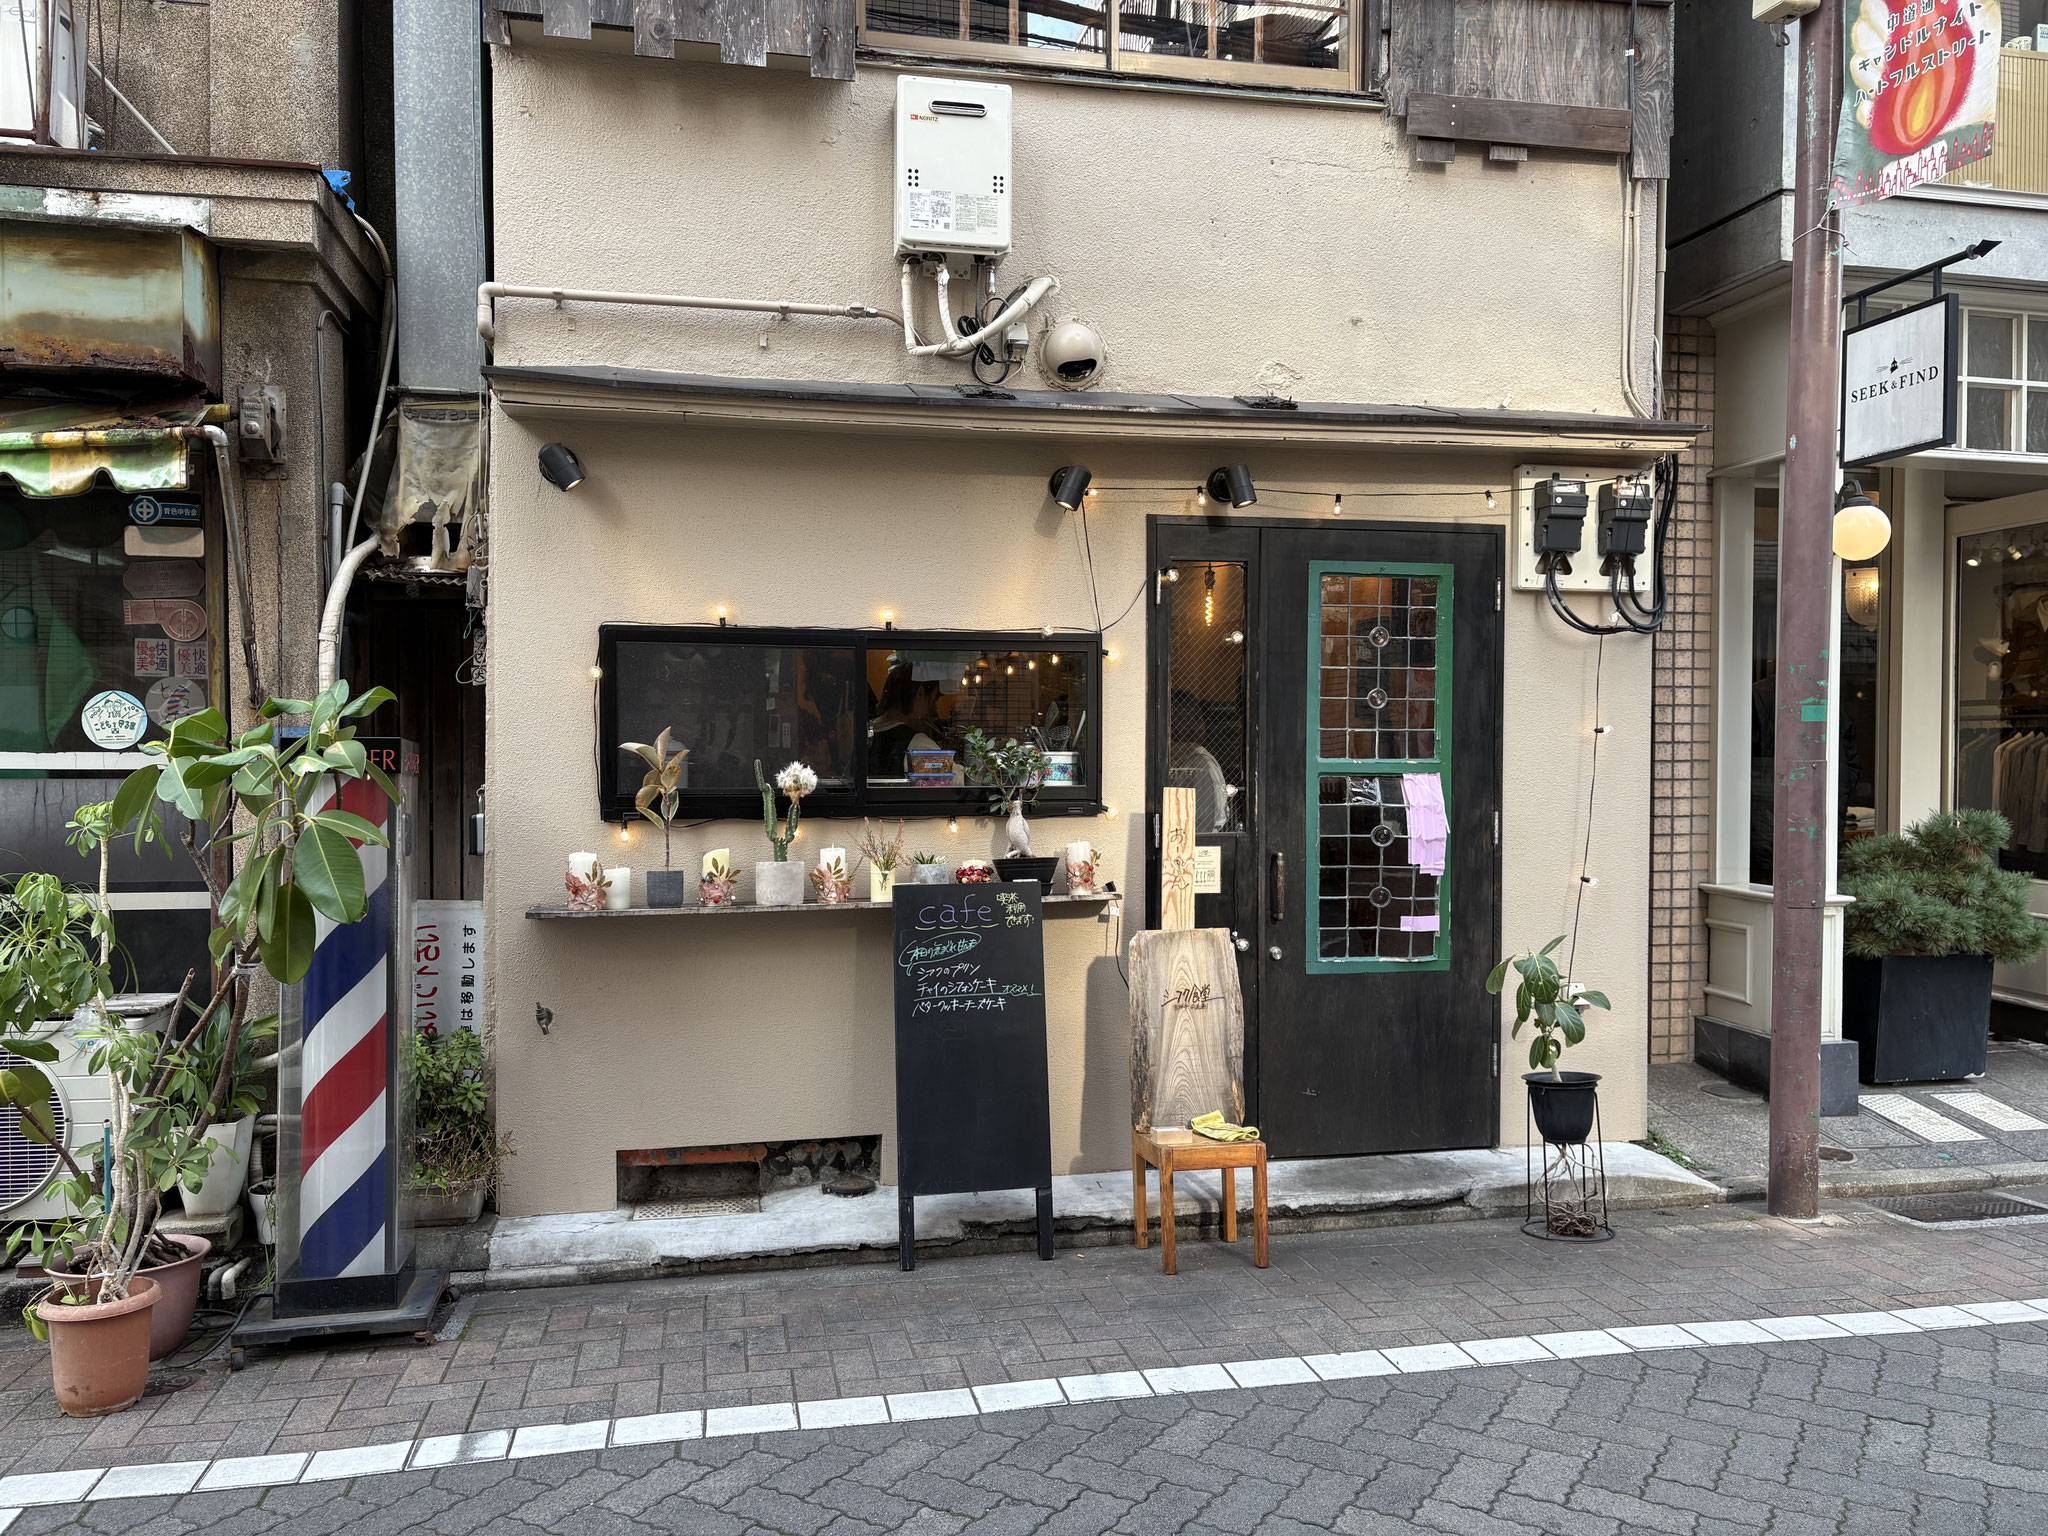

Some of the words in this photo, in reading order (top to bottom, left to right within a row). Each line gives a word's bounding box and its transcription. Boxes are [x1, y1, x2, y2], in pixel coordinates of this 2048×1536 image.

[1858, 2, 1983, 72] キャンドルナイト
[1853, 29, 1992, 108] ハートフルストリート
[1851, 380, 1889, 403] SEEK
[1890, 380, 1898, 389] &
[1899, 365, 1939, 389] FIND
[155, 641, 168, 672] 快適
[919, 894, 992, 924] cafe
[1005, 902, 1026, 915] 利用
